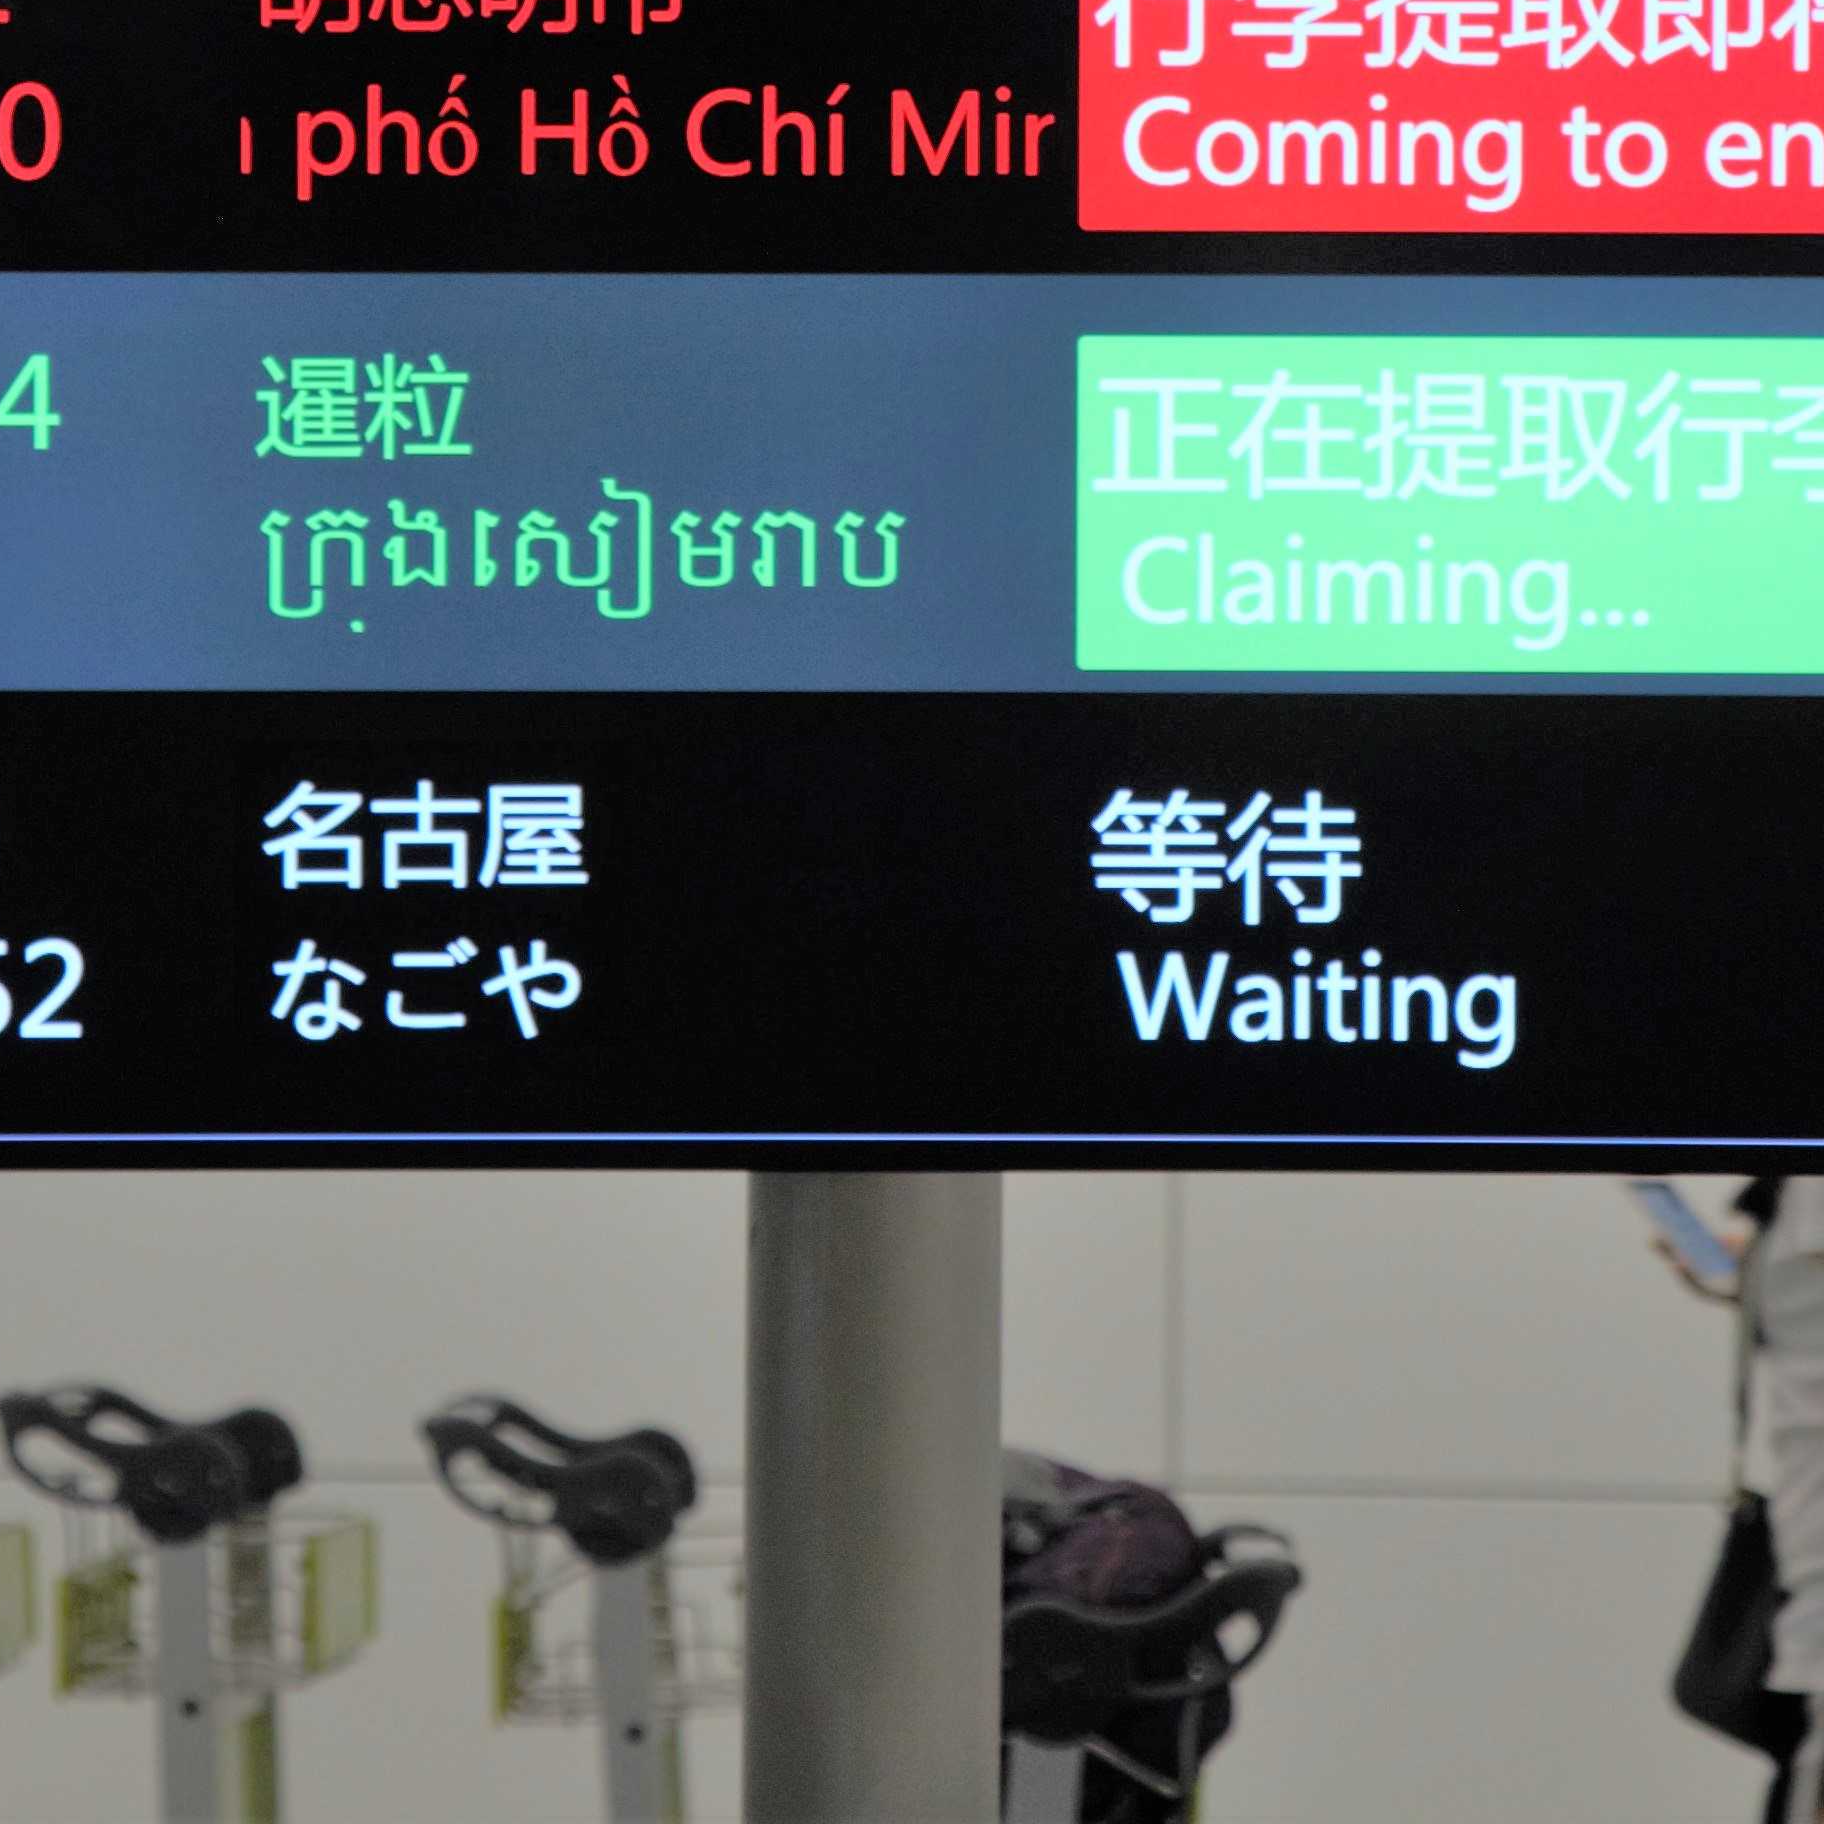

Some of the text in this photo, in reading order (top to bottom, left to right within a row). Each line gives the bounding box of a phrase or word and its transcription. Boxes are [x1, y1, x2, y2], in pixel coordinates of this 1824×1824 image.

[297, 74, 478, 201] phố
[521, 74, 649, 176] Hồ
[686, 83, 849, 177] Chí
[1124, 94, 1523, 212] Coming
[1562, 106, 1668, 188] to
[255, 353, 472, 460] 暹粒
[1122, 531, 1651, 651] Claiming...
[264, 780, 588, 888] 名古屋
[1092, 790, 1361, 925] 等待
[273, 938, 580, 1039] なごや
[1118, 949, 1515, 1068] Waiting
